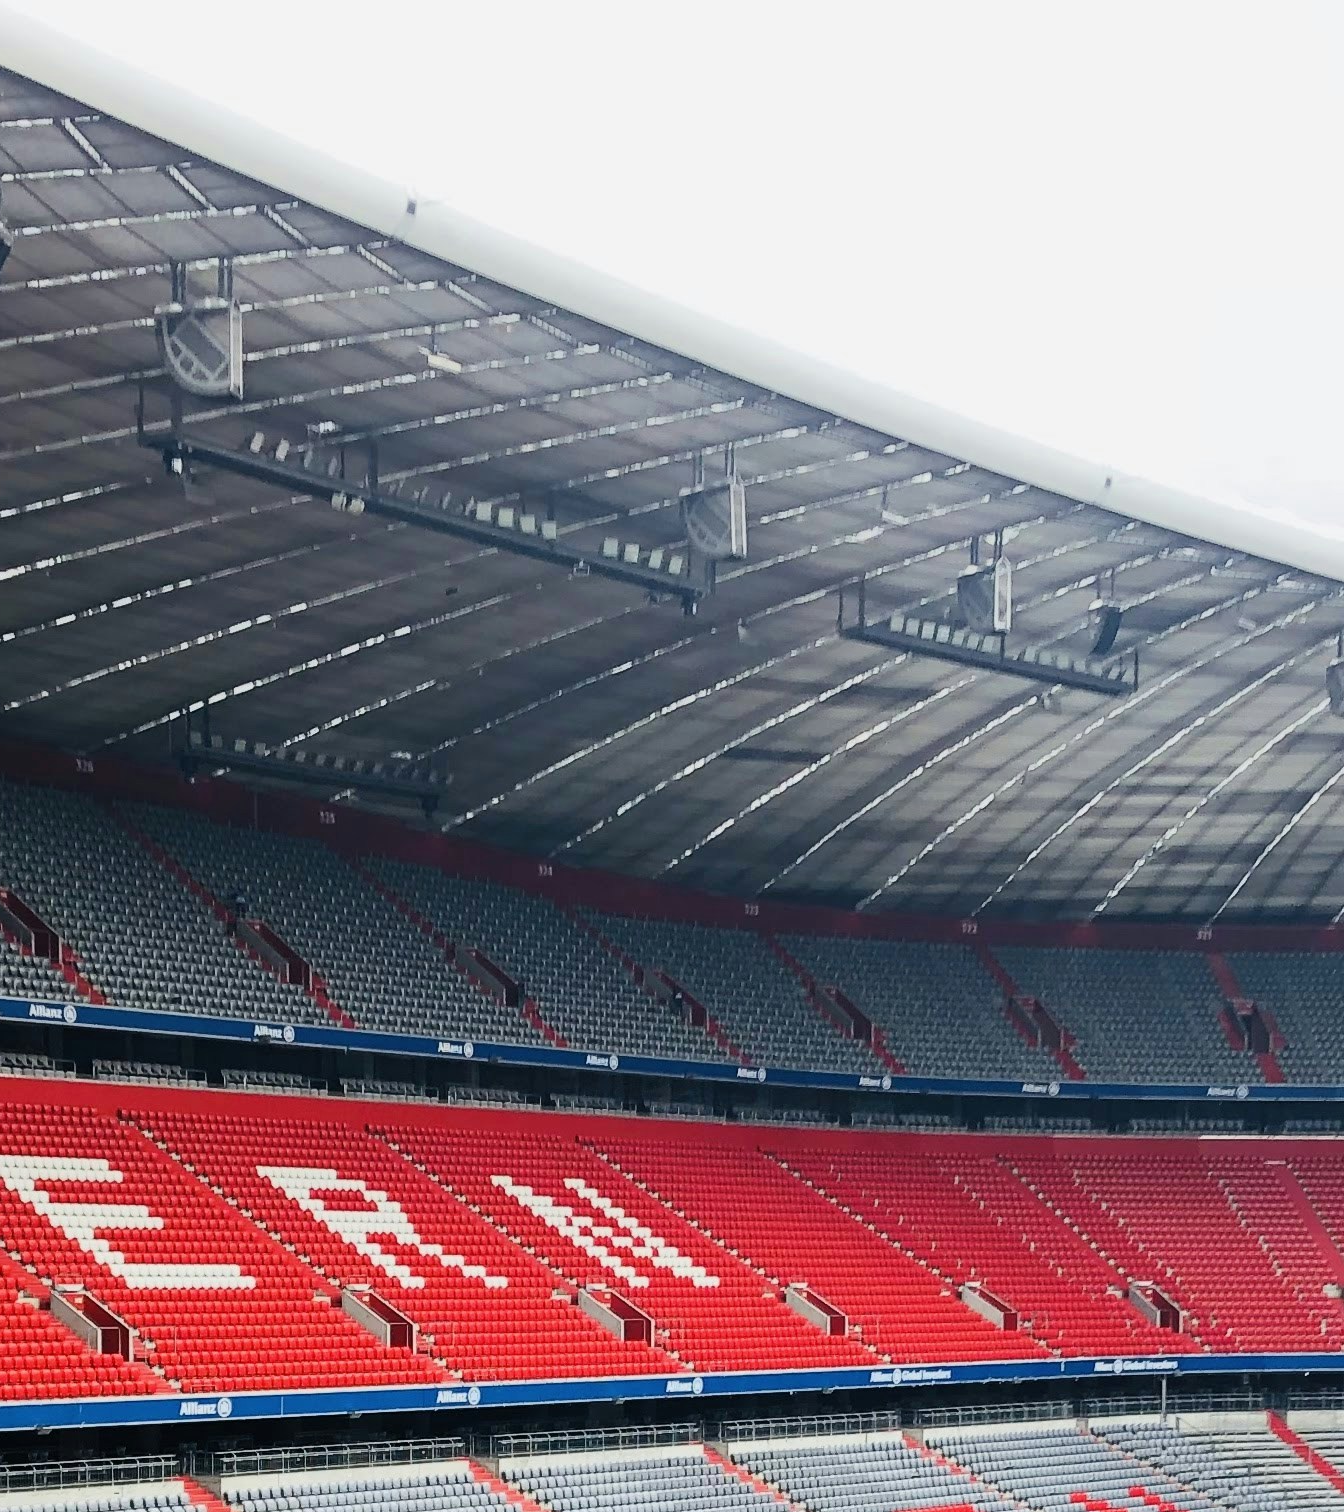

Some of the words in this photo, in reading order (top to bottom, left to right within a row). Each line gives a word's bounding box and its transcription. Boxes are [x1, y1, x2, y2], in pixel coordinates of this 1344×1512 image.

[29, 1003, 63, 1019] Allianz
[253, 1024, 283, 1039] Allianz
[437, 1041, 463, 1055] Allianz
[665, 1380, 693, 1393] Allianz
[436, 1390, 468, 1404] Allianz
[179, 1401, 217, 1416] Allianz
